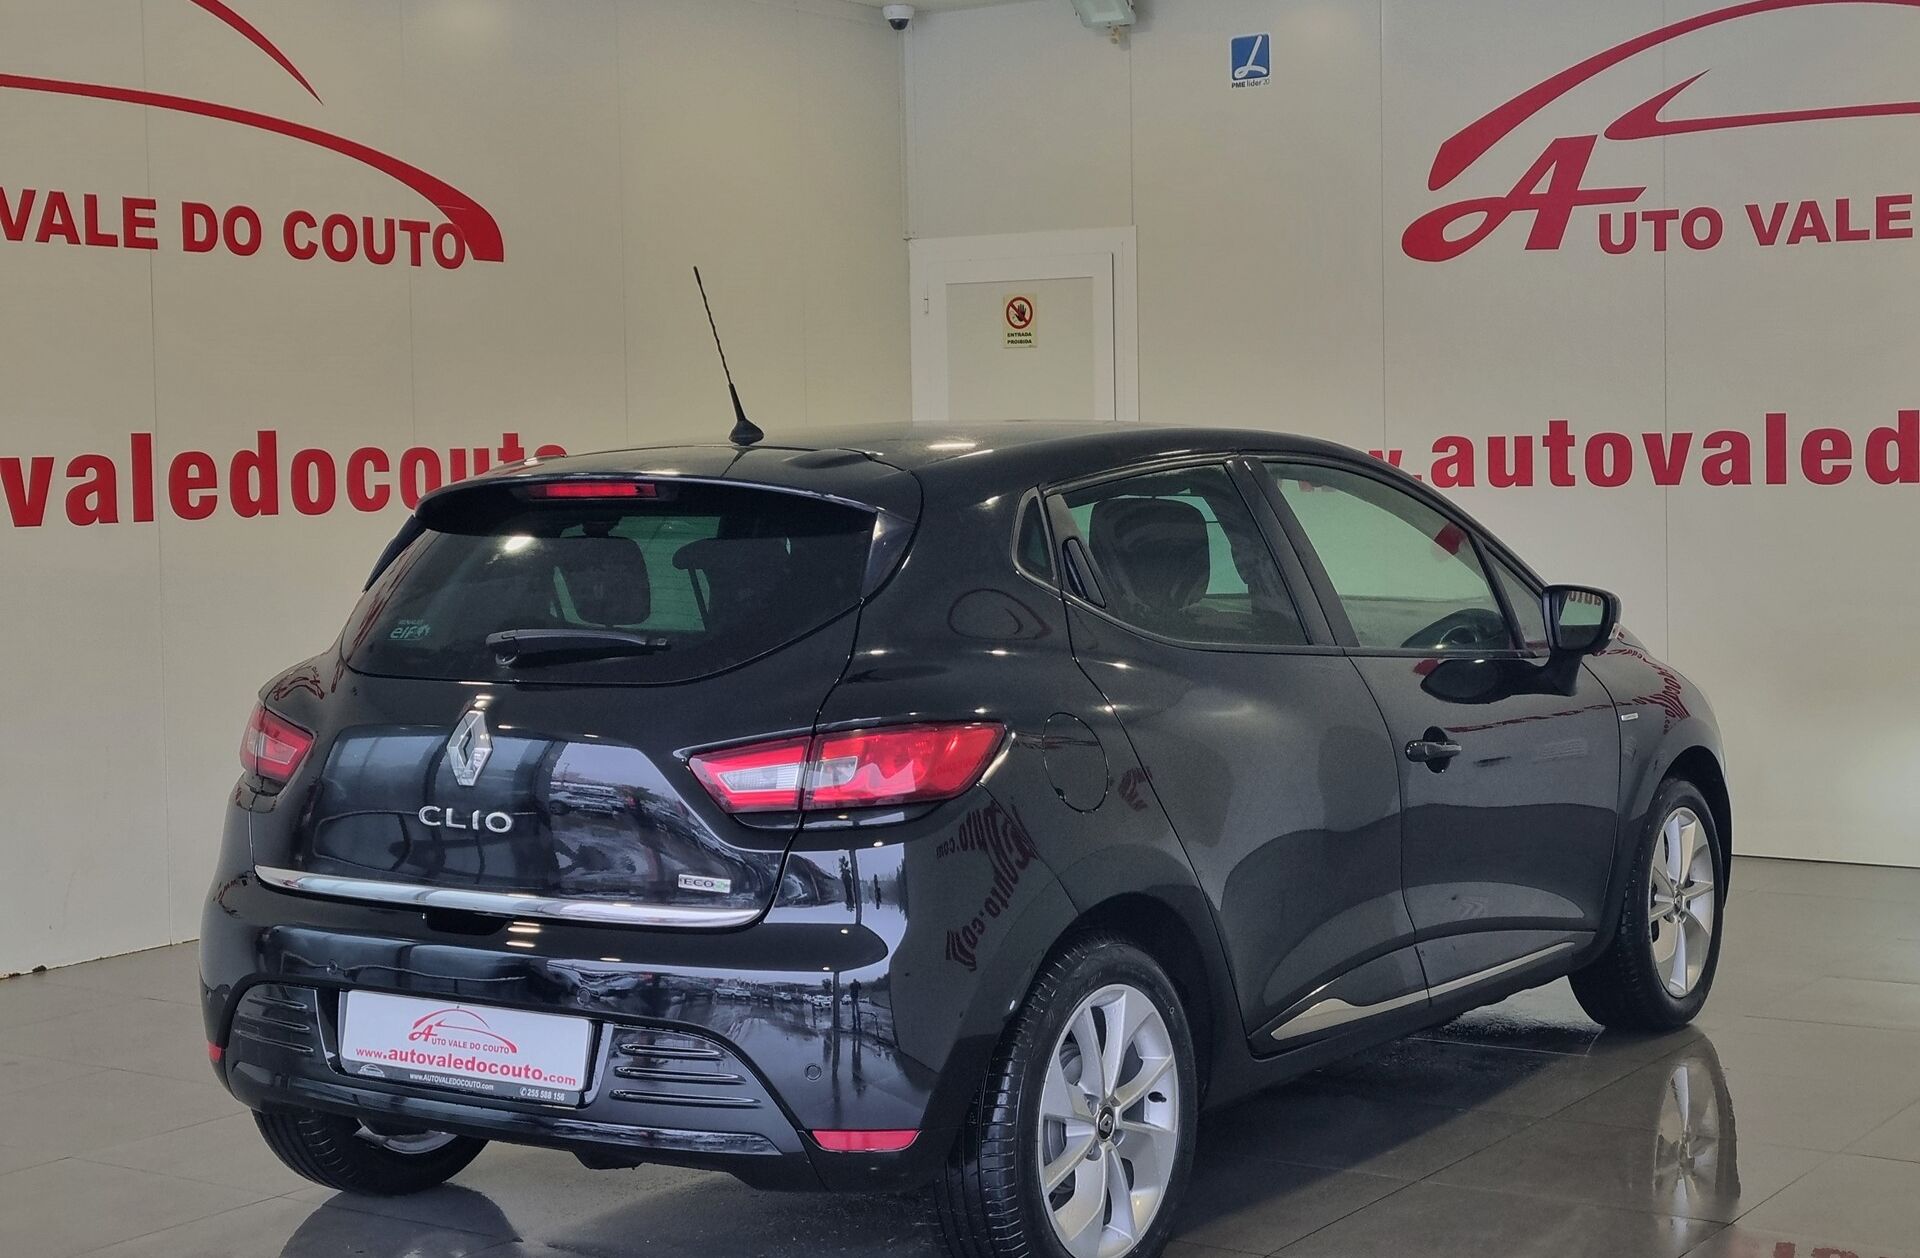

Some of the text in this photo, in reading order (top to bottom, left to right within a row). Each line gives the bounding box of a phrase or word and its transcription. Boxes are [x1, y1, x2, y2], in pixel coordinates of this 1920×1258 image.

[0, 186, 467, 269] VALE DO COUTO
[1745, 193, 1915, 246] VALE
[418, 805, 513, 833] CLIO
[448, 1039, 468, 1049] VALE
[469, 1042, 481, 1050] DO
[482, 1044, 510, 1054] COUTO
[356, 1048, 576, 1086] www.autovaledocouto.com
[409, 1073, 494, 1091] www.AUTOVALEDOCOUTO.com
[527, 1088, 539, 1098] 255
